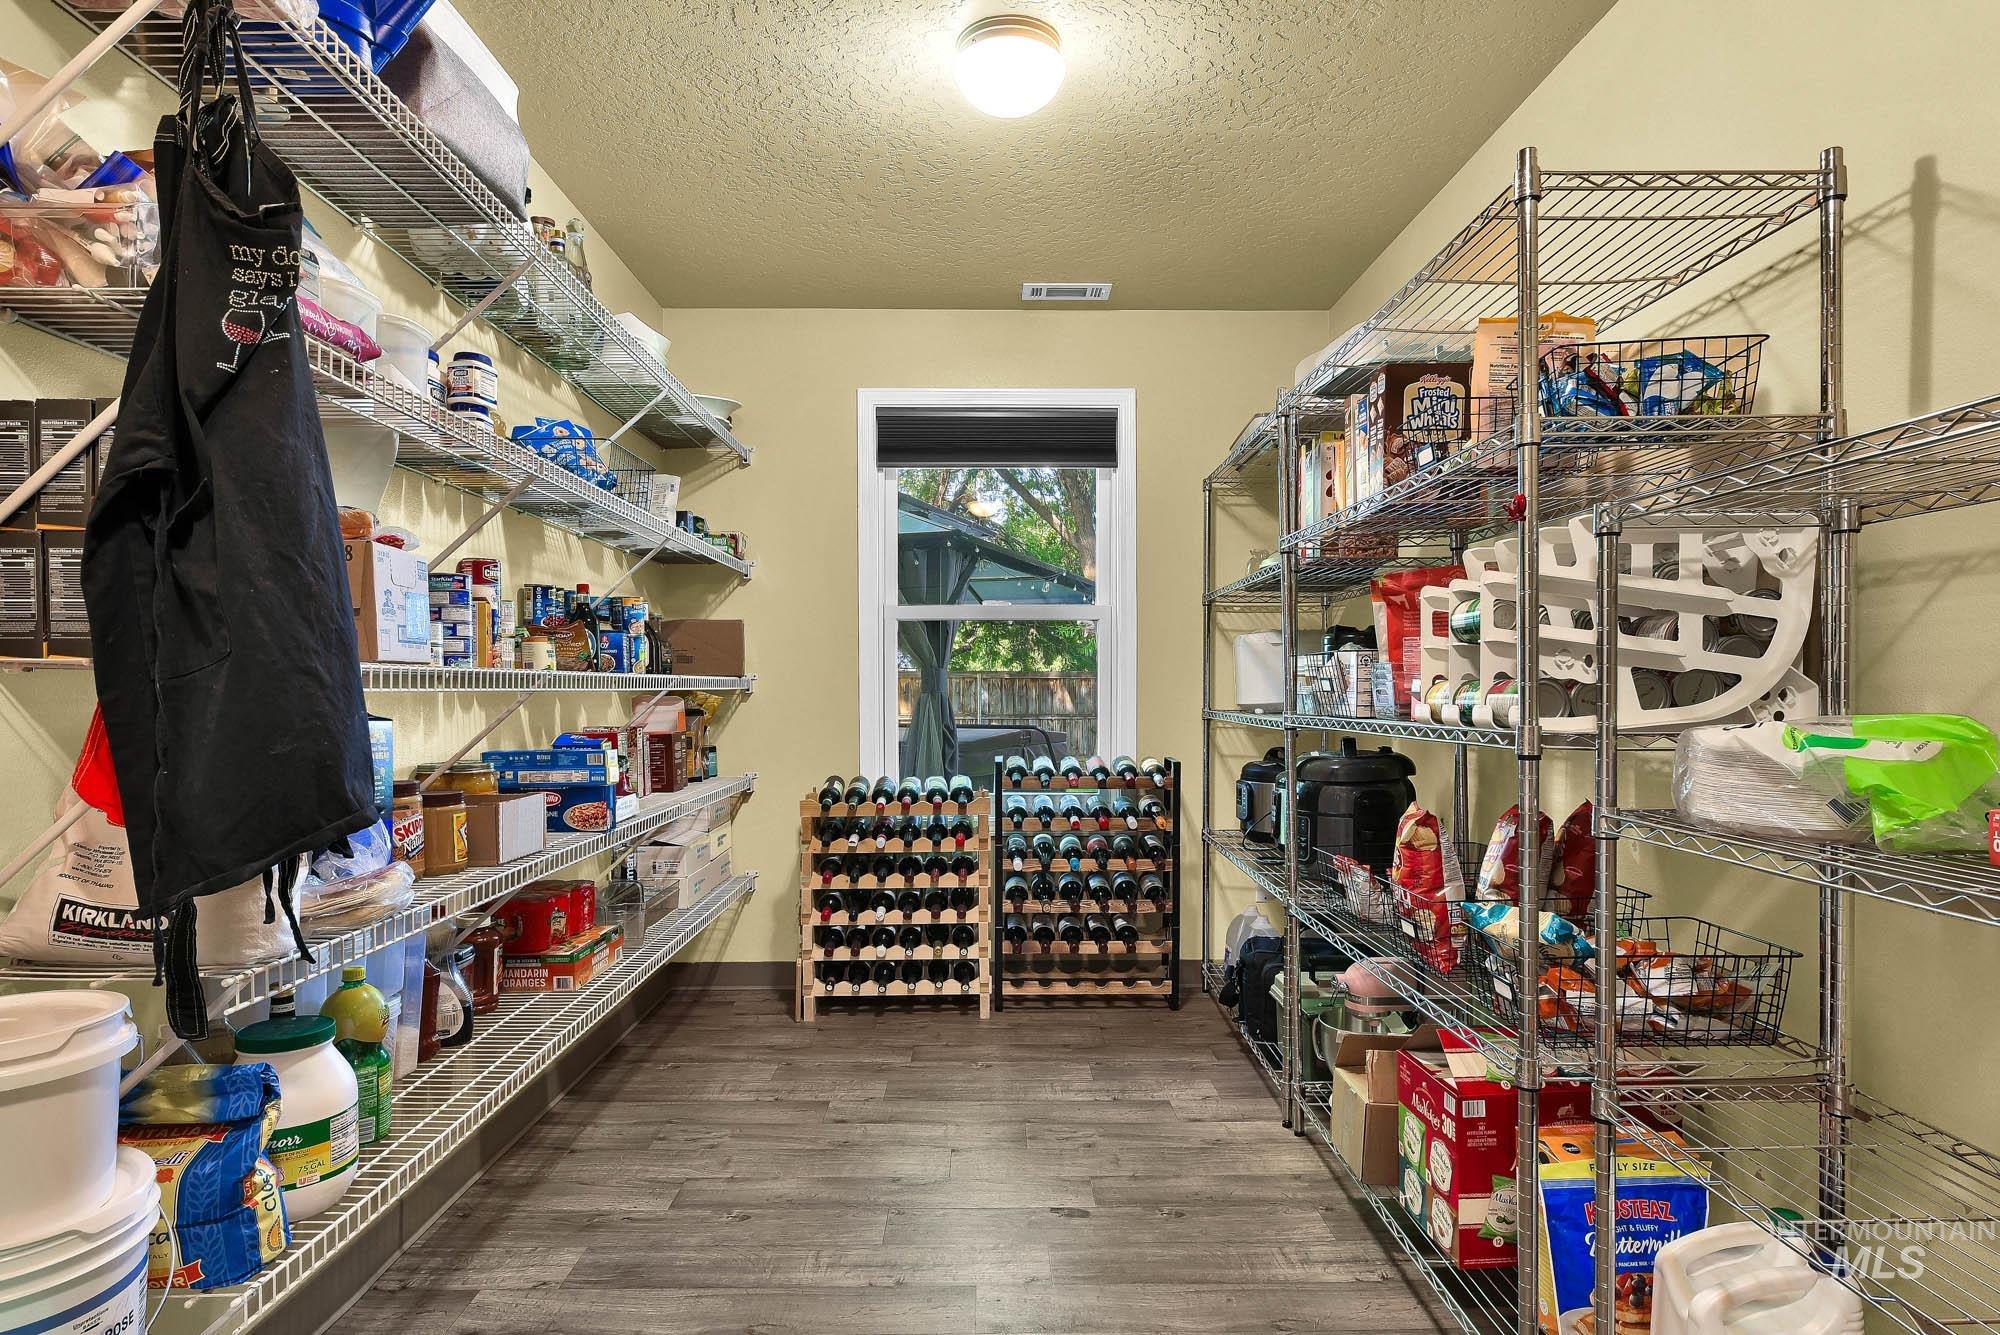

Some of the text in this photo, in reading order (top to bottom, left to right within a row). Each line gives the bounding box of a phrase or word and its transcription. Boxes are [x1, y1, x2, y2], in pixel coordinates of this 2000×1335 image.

[229, 245, 265, 267] my
[232, 268, 283, 290] says
[1420, 374, 1452, 385] Kellogg's
[1419, 387, 1450, 398] Frosted
[503, 978, 546, 988] ORANGES
[1441, 1113, 1453, 1139] 30
[299, 1160, 326, 1174] 75 GAL
[1632, 1162, 1656, 1171] SIZE
[1636, 1224, 1659, 1232] FLUFFY
